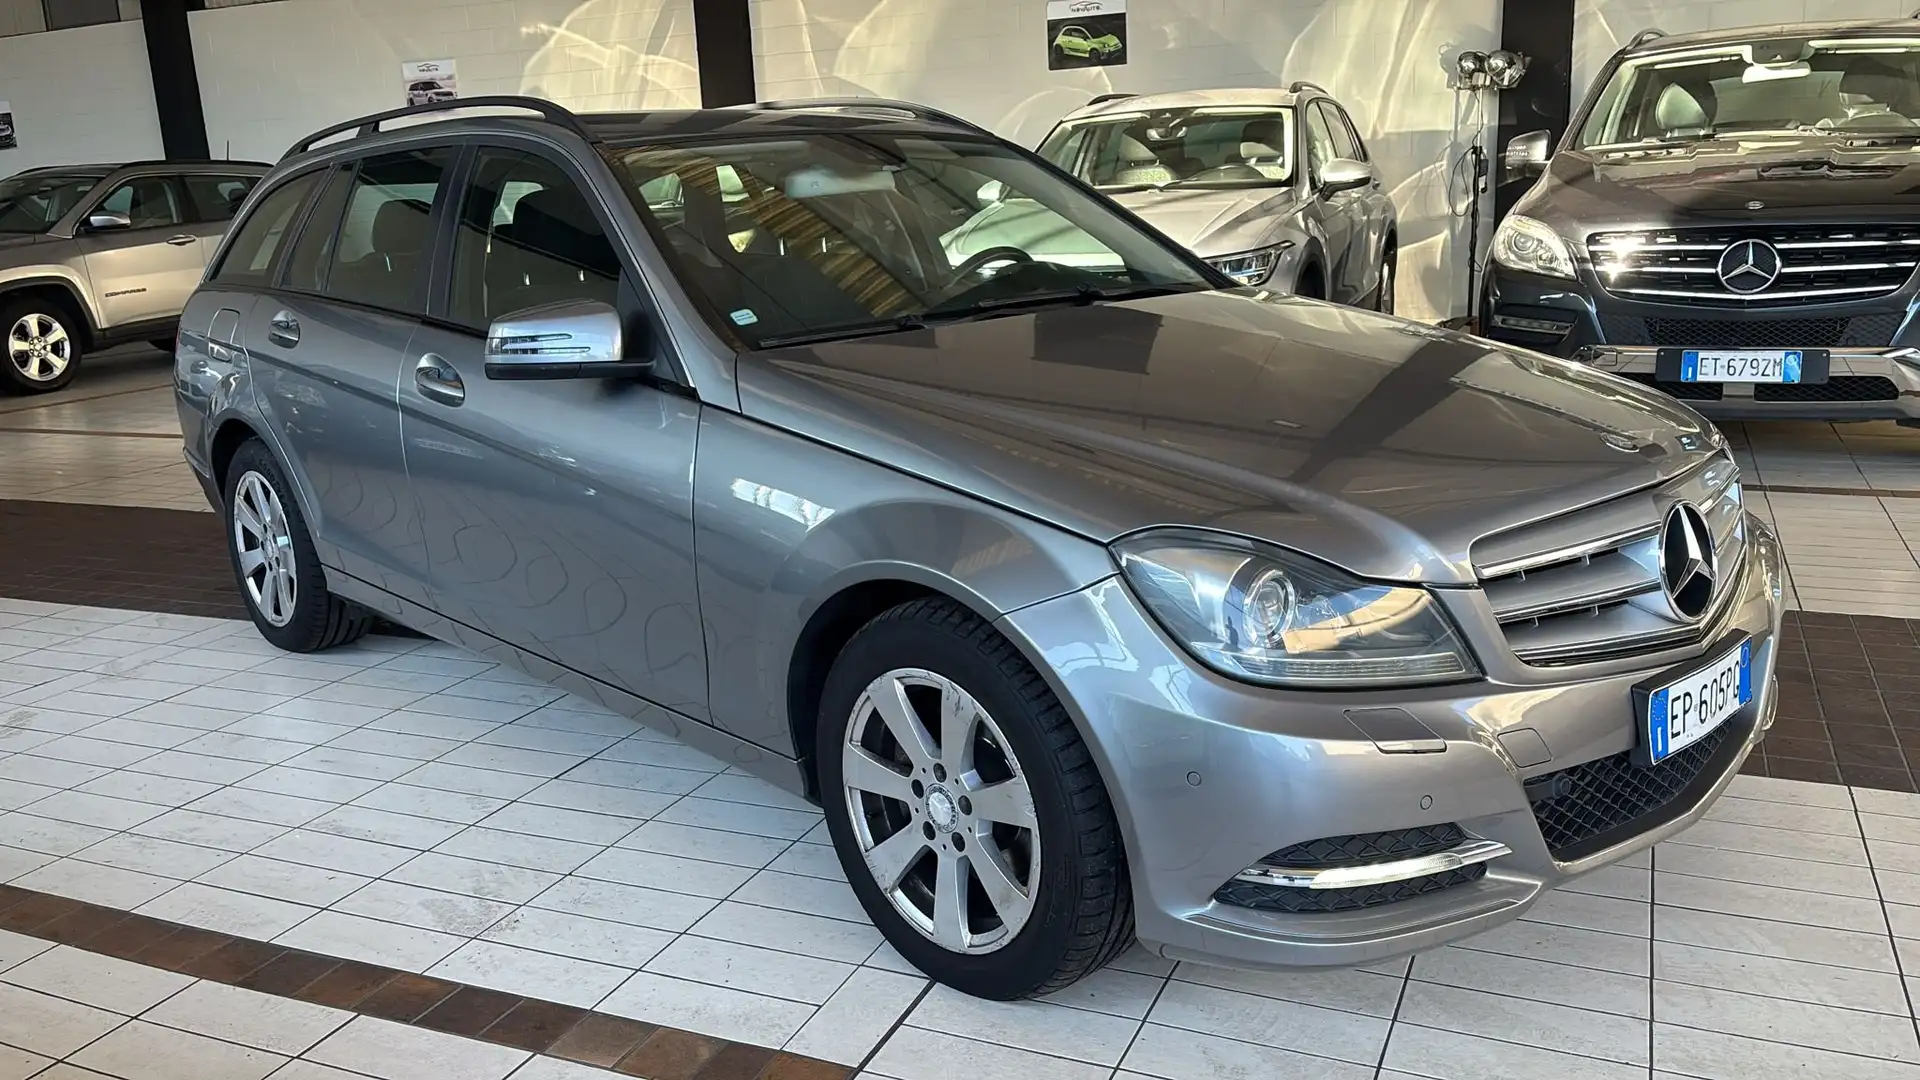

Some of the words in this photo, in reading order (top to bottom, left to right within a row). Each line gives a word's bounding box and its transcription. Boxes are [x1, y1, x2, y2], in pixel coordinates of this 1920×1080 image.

[1699, 357, 1721, 377] ET
[1726, 357, 1783, 377] 679ZM
[1670, 691, 1693, 740] EP
[1699, 660, 1740, 725] 605PG
